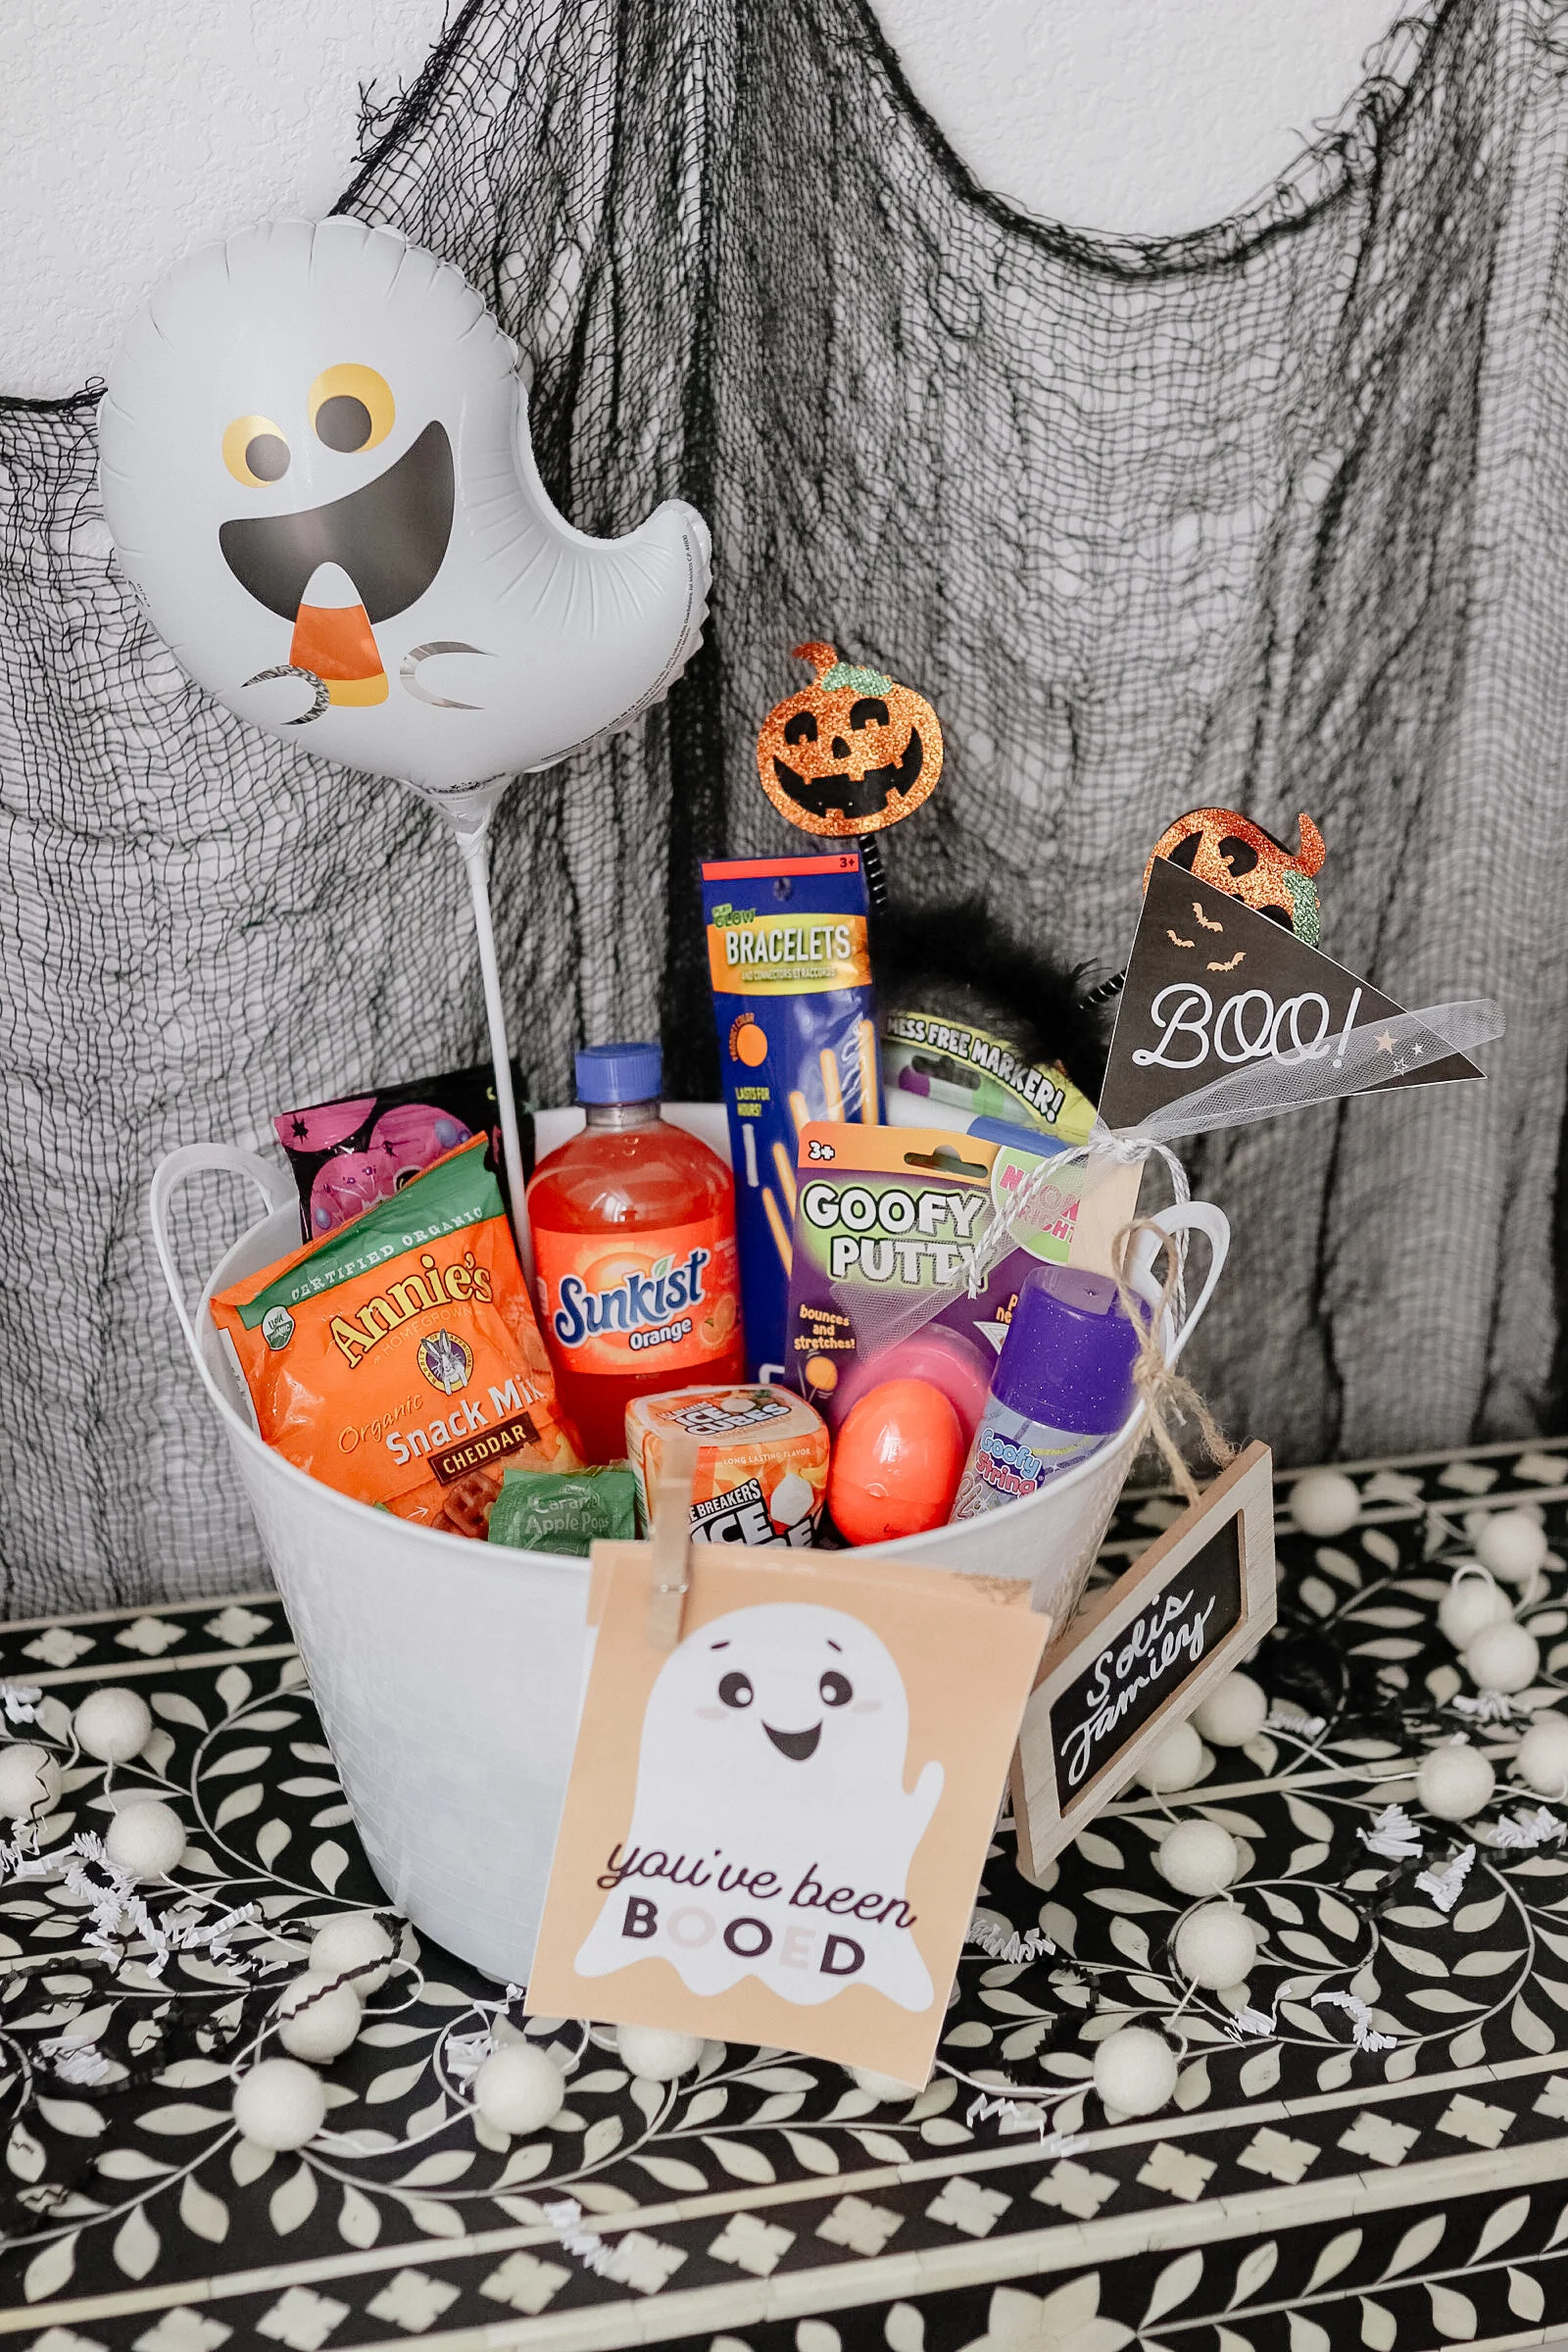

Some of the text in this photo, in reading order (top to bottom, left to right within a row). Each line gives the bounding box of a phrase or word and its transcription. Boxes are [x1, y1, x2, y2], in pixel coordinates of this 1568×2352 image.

[840, 858, 856, 868] 3+
[714, 907, 757, 928] GLOW
[726, 925, 852, 965] BRACELETS
[1132, 982, 1363, 1069] BOO!
[887, 1017, 1065, 1123] MESS FREE MARKER!
[808, 1140, 836, 1161] 3+
[804, 1183, 987, 1238] GOOFY
[291, 1207, 484, 1300] CERTIFIED ORGANIC
[329, 1250, 494, 1369] Annie's
[555, 1250, 709, 1346] Sunkist
[799, 1304, 850, 1326] bounces
[381, 1307, 474, 1357] HOMEGROWN
[629, 1317, 692, 1350] Orange
[793, 1335, 856, 1350] stretches!
[812, 1324, 835, 1336] and
[338, 1393, 423, 1454] Organic
[385, 1398, 489, 1465] Snack
[675, 1406, 732, 1427] ICE
[685, 1402, 791, 1436] CUBES
[443, 1424, 526, 1474] CHEDDAR
[723, 1447, 811, 1465] LONG LASTING FLAVOR
[981, 1428, 1042, 1481] Goofy
[696, 1478, 761, 1517] BREAKERS
[975, 1450, 1037, 1499] String
[525, 1513, 579, 1536] Apple
[1086, 1588, 1196, 1707] Solis
[596, 1842, 918, 1931] you've been
[620, 1895, 866, 1976] BOOED
